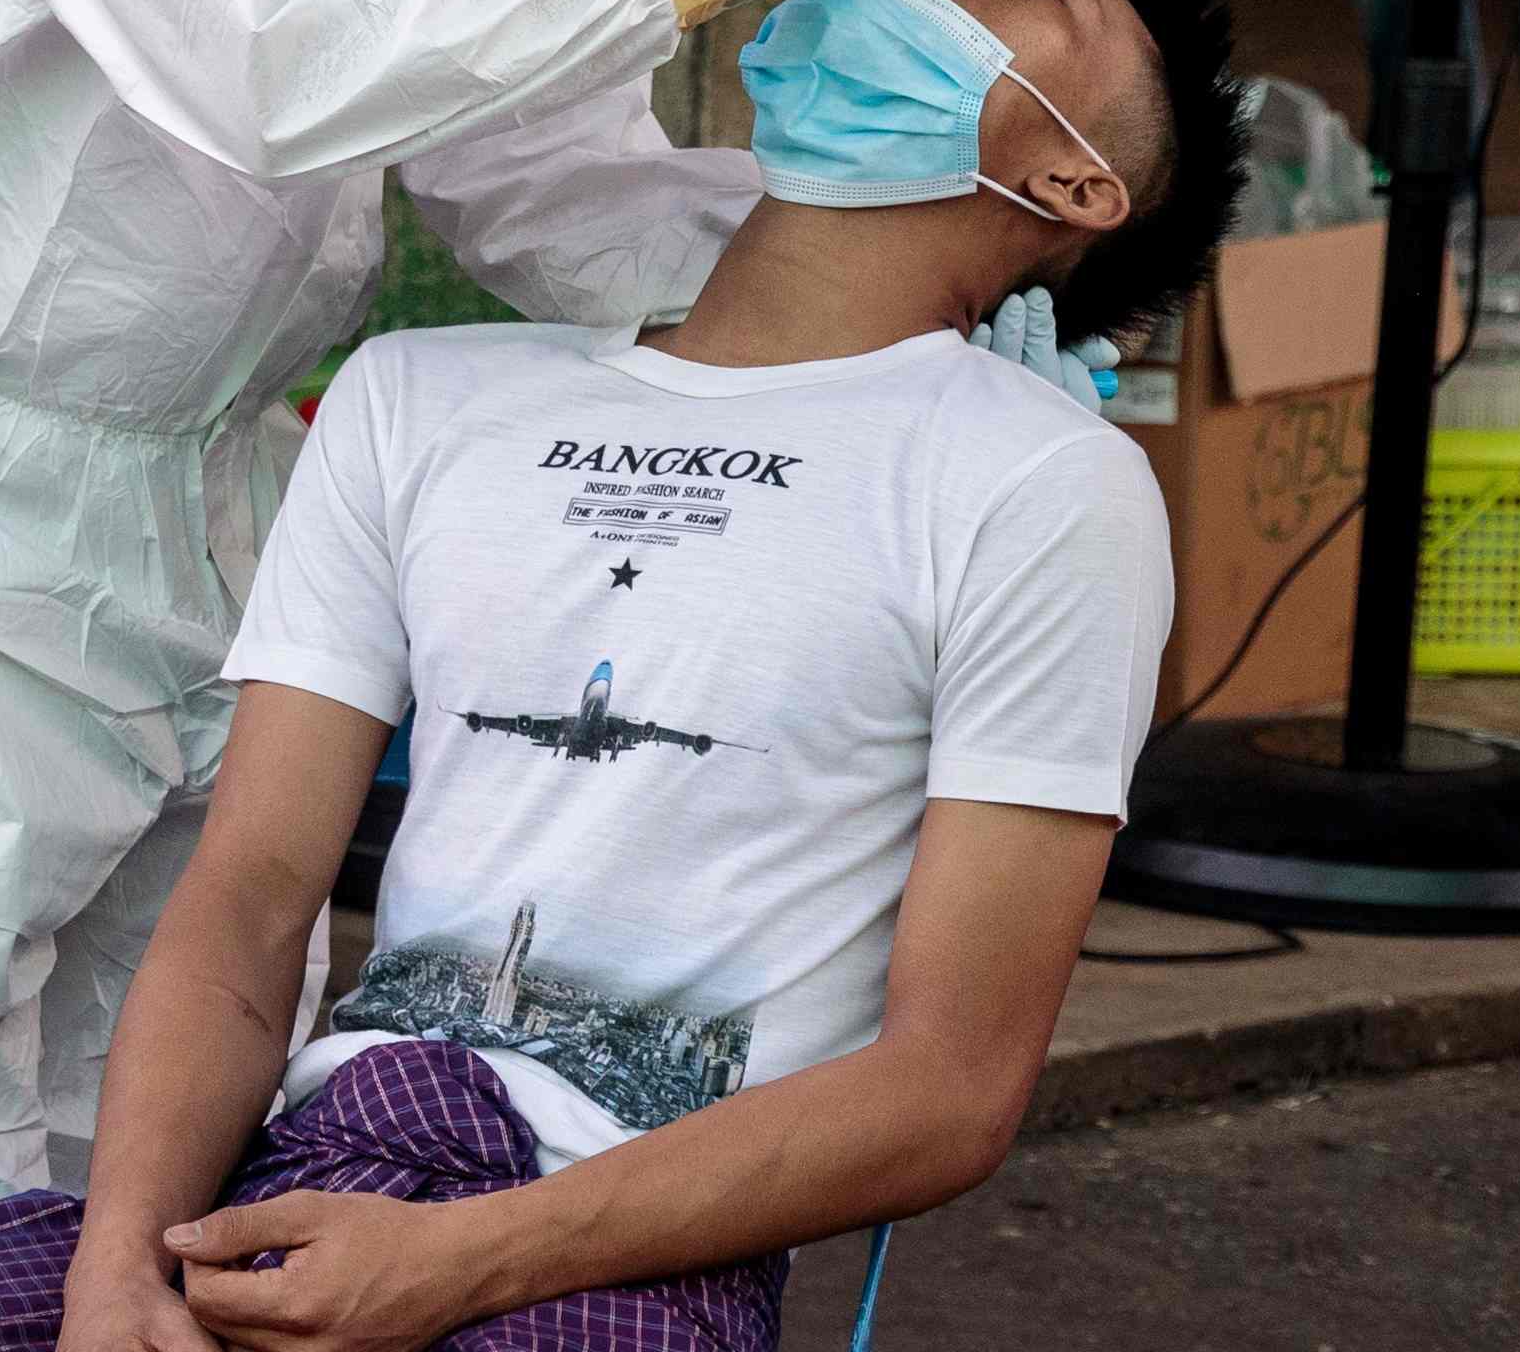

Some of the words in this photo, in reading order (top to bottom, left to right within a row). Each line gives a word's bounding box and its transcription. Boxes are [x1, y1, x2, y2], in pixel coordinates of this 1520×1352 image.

[537, 440, 803, 489] BANGKOK
[583, 481, 632, 498] INSPIRED
[633, 482, 681, 499] FASHION
[682, 485, 726, 502] SEARCH
[571, 506, 592, 519] THE
[597, 508, 648, 520] FASHION
[657, 510, 674, 521] OF
[684, 513, 724, 526] ASIAN
